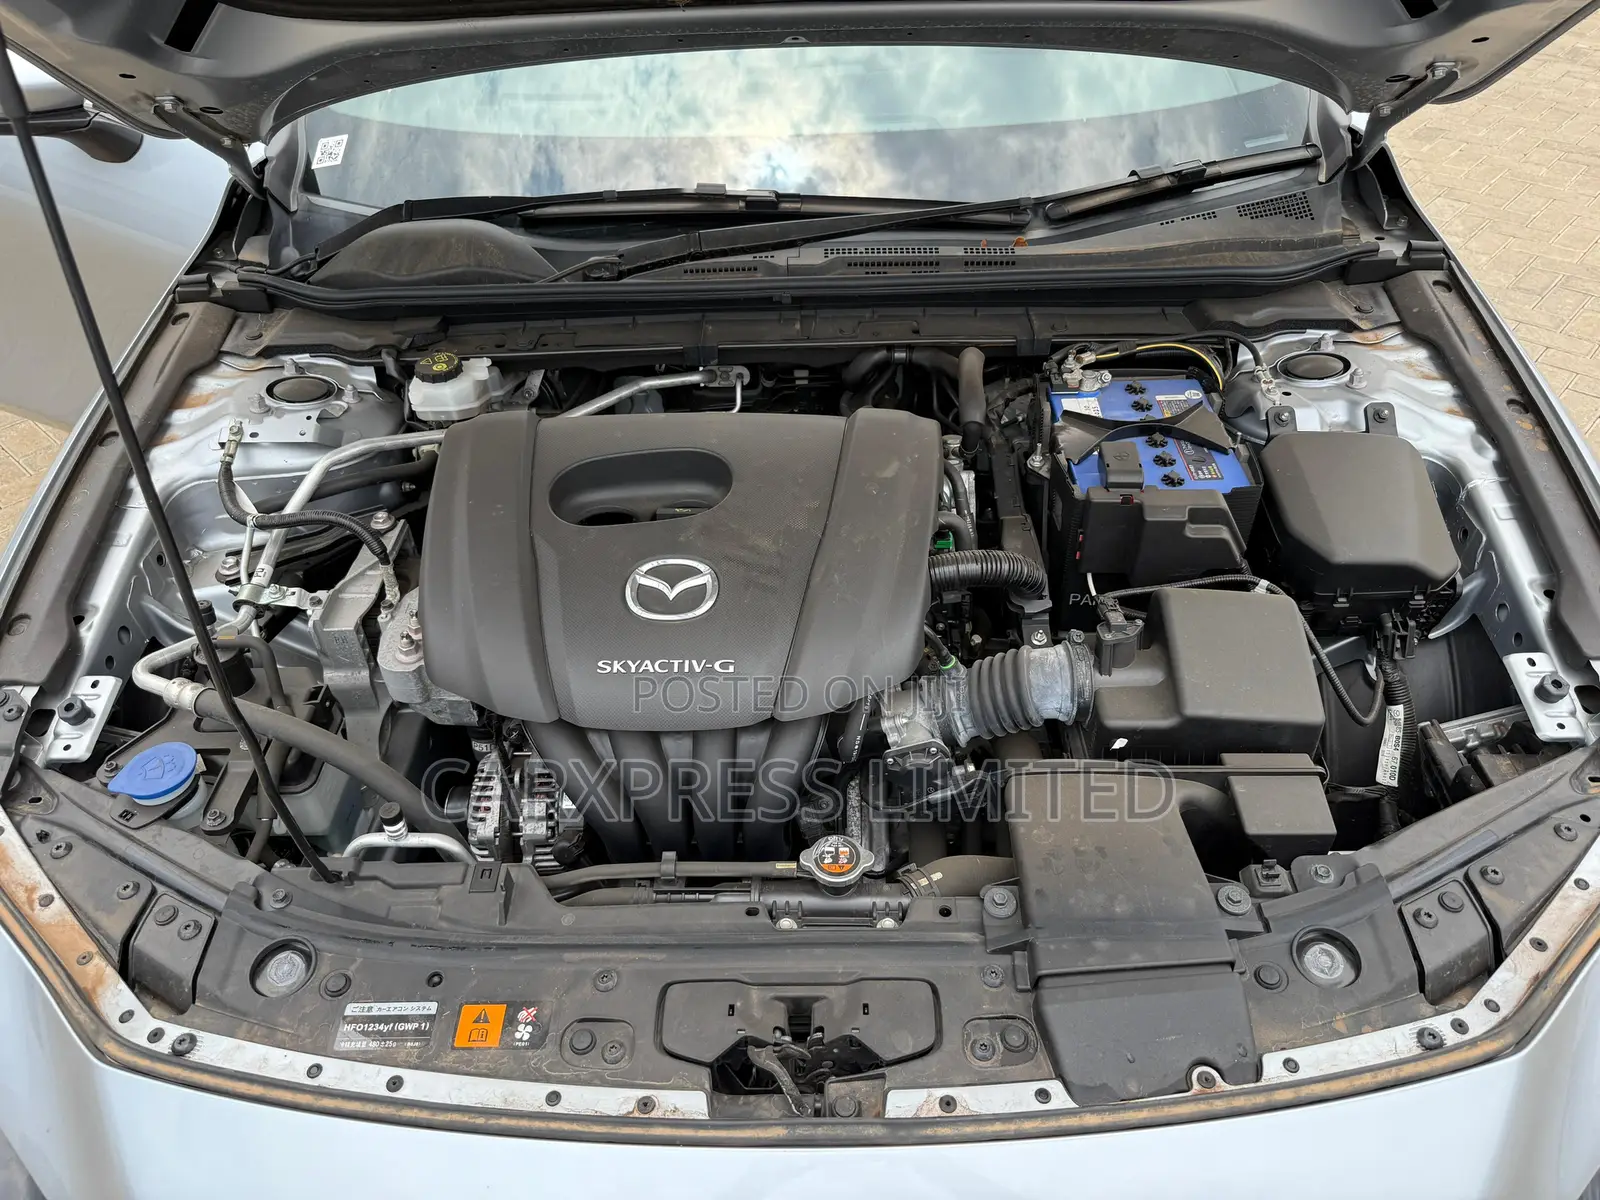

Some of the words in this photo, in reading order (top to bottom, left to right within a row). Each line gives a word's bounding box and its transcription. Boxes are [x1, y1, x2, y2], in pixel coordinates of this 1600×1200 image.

[1069, 593, 1096, 606] PA
[596, 659, 736, 674] SKYACTIV-G
[351, 1005, 374, 1014] ご注意
[343, 1022, 394, 1034] HFO1234yf
[394, 1022, 420, 1032] (GWP
[420, 1022, 430, 1031] 1)
